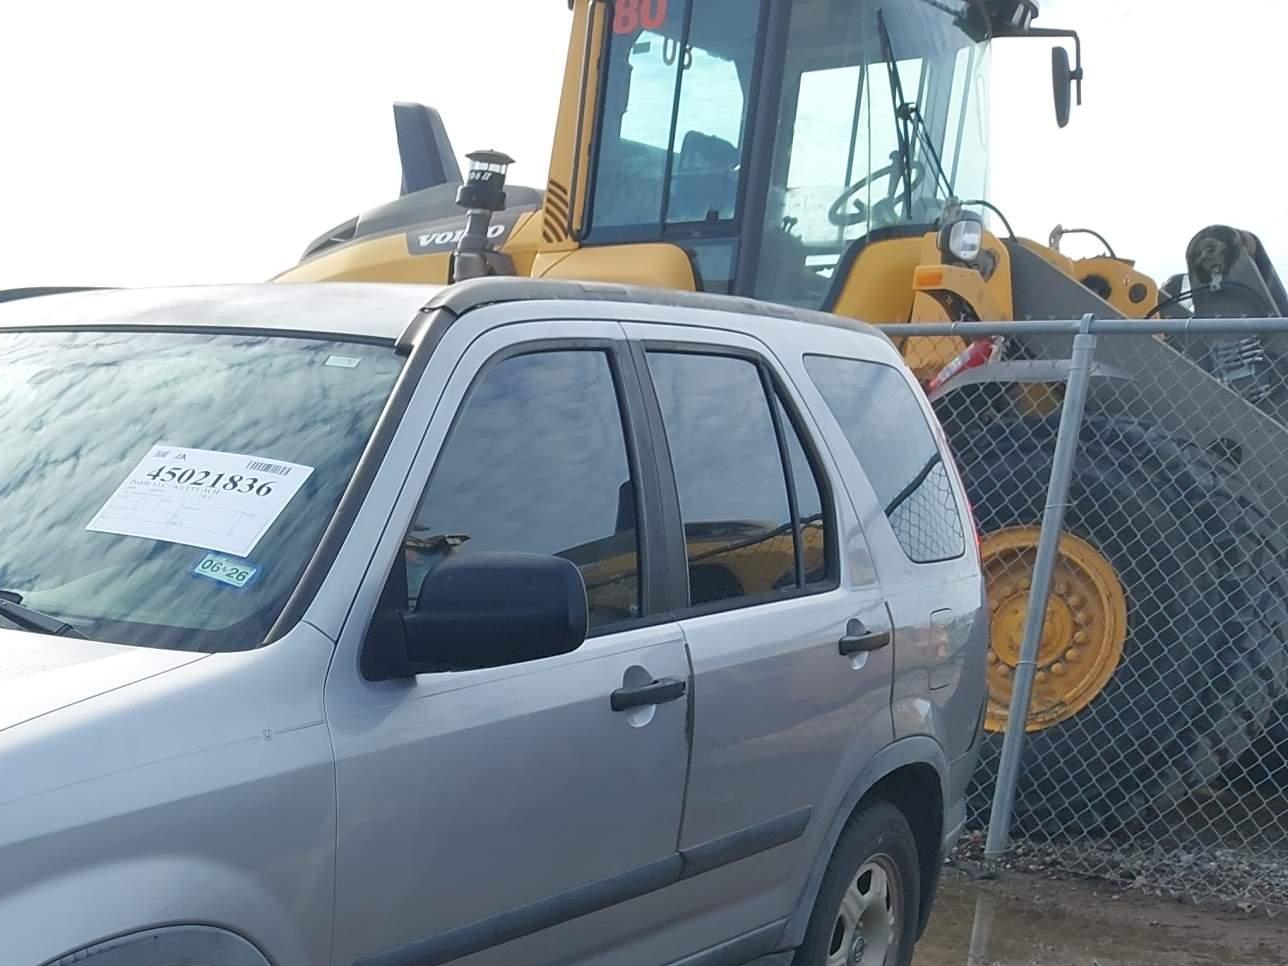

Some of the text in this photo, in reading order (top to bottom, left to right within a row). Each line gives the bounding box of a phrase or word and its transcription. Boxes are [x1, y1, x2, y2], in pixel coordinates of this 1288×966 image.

[613, 0, 668, 34] 80
[418, 224, 505, 247] VOLO
[146, 465, 279, 497] 45021836
[202, 559, 249, 582] 06 26
